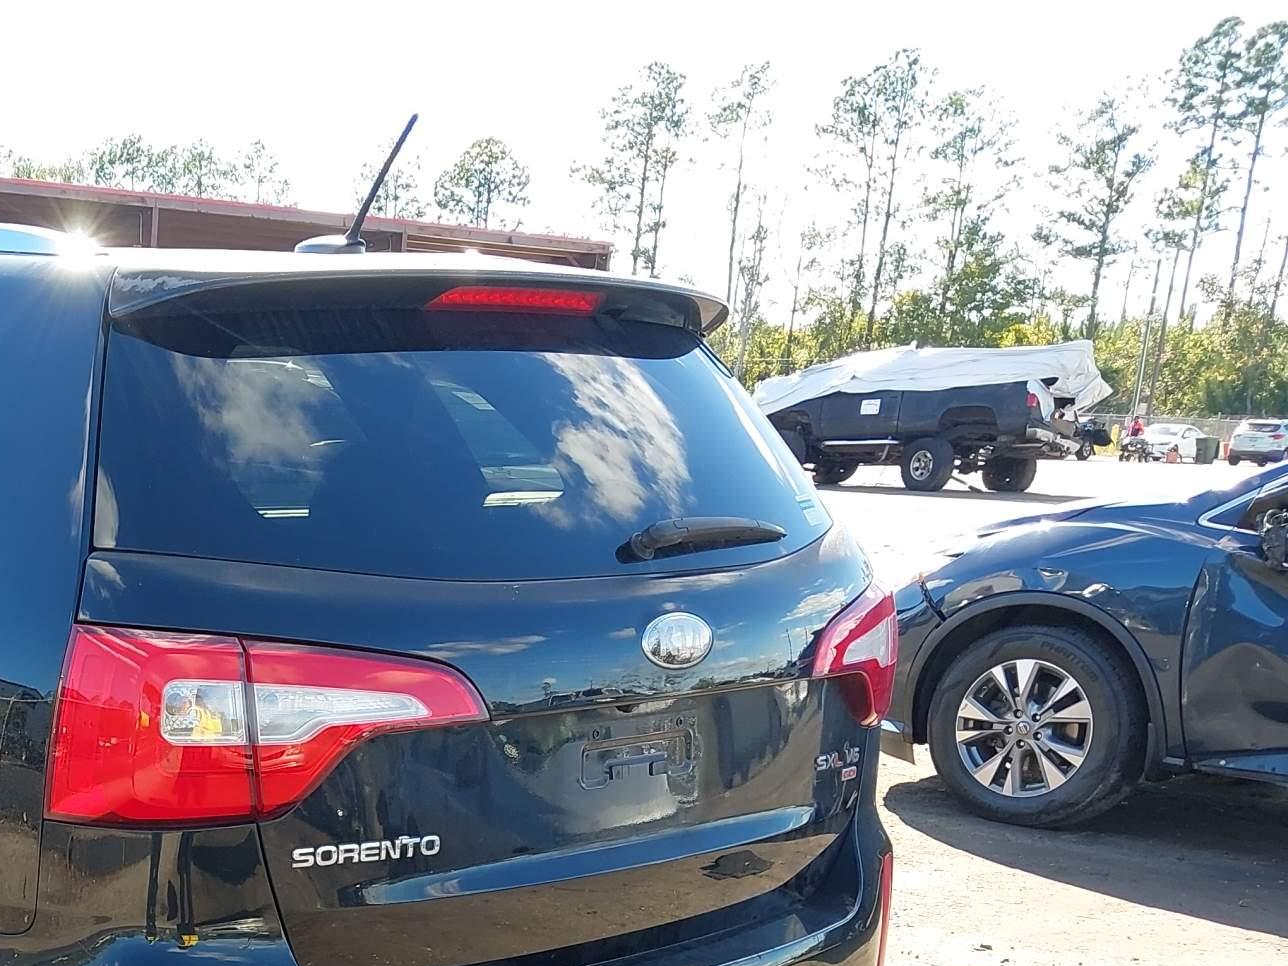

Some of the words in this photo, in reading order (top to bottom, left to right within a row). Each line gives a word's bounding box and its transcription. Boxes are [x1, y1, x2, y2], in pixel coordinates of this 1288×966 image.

[816, 752, 843, 770] SXL
[844, 747, 860, 764] V6
[292, 835, 441, 868] SORENTO
